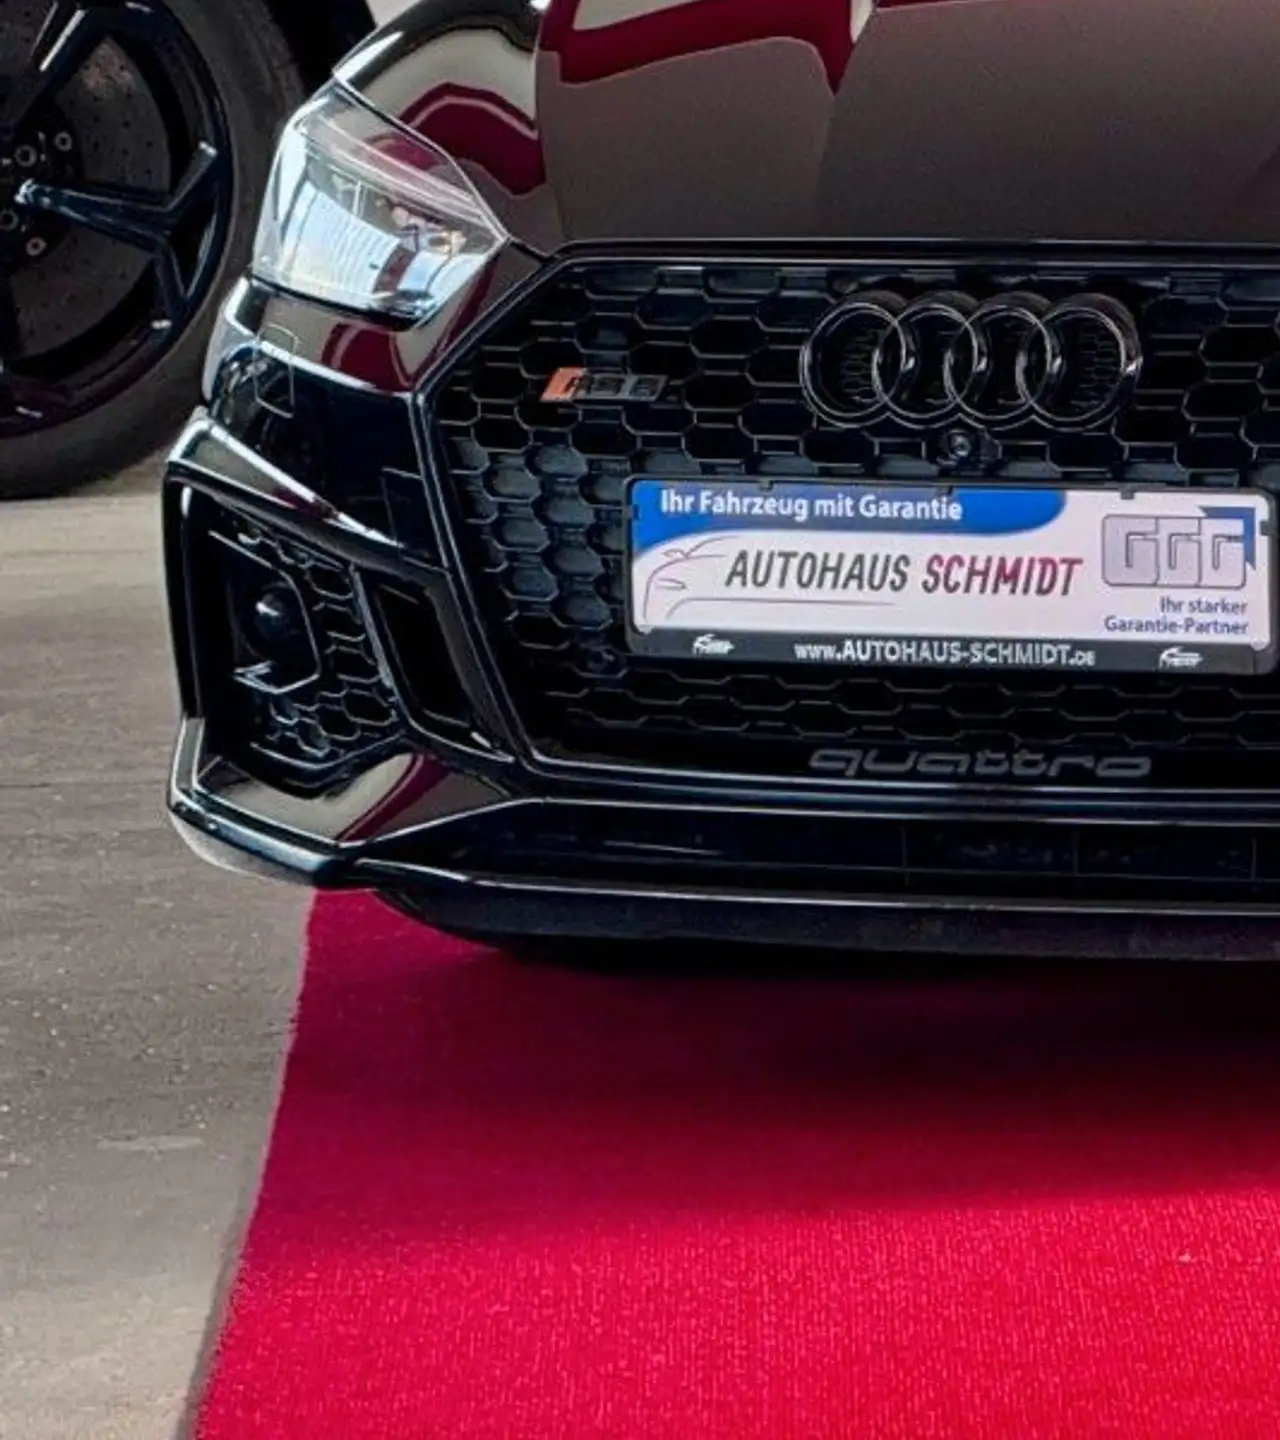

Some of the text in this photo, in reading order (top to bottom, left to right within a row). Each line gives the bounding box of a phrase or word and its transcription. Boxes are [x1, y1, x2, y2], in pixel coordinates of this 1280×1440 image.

[660, 488, 963, 523] Ihr Fahrzeug mit Garantie
[724, 548, 1084, 597] AUTOHAUS SCHMIDT
[1159, 595, 1248, 616] Ihr starker
[1103, 614, 1249, 636] Garantie-Partner
[808, 748, 1152, 778] quattro
